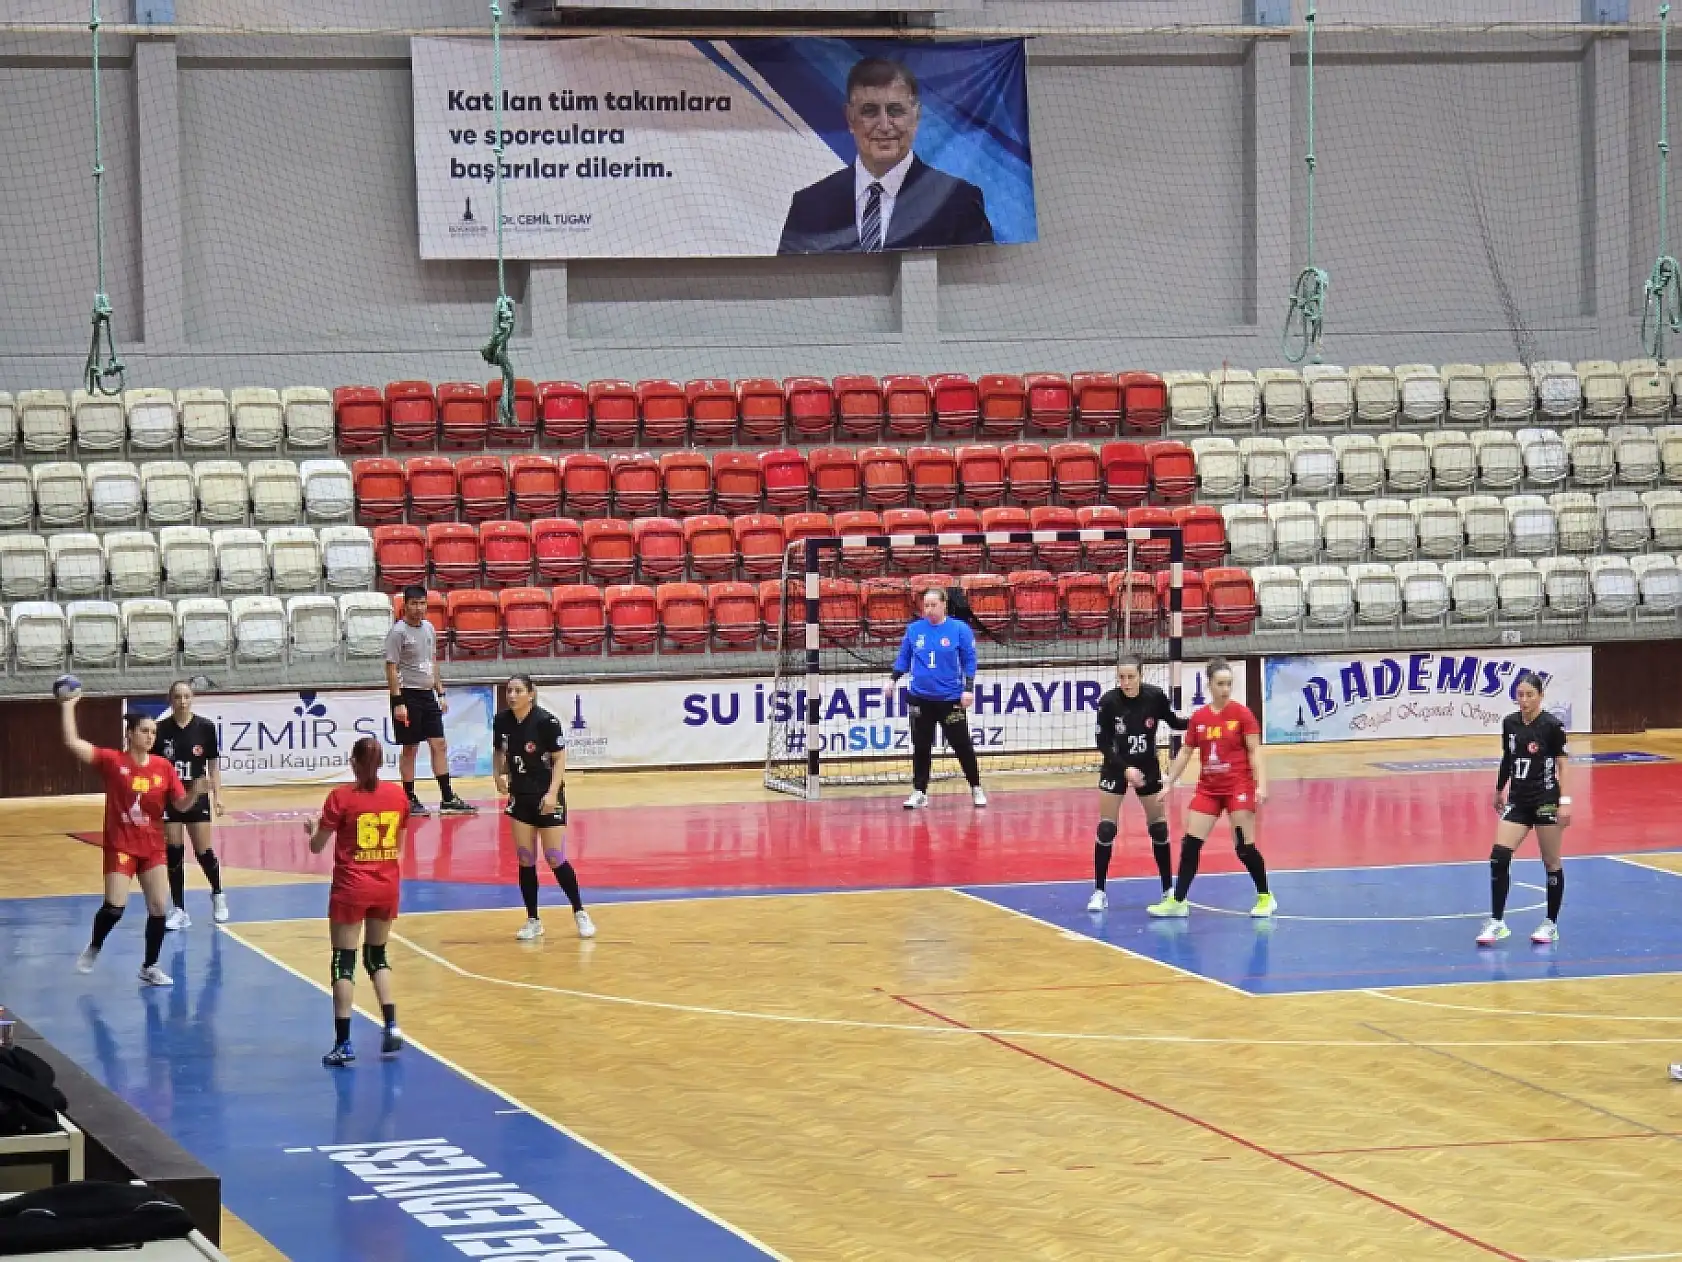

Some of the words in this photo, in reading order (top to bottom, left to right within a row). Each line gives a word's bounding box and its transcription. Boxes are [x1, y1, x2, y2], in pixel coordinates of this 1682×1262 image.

[448, 89, 541, 111] Katlan
[548, 89, 598, 111] tüm
[604, 89, 731, 111] takımlara
[448, 128, 477, 145] ve
[484, 122, 624, 149] sporculara
[450, 157, 569, 184] başarılar
[576, 156, 673, 178] dilerim.
[927, 650, 937, 669] 1
[682, 692, 740, 727] SU
[974, 680, 1103, 715] HAYIR
[1127, 733, 1148, 755] 25
[514, 755, 527, 774] 2
[1514, 757, 1532, 780] 17
[356, 810, 400, 849] 67
